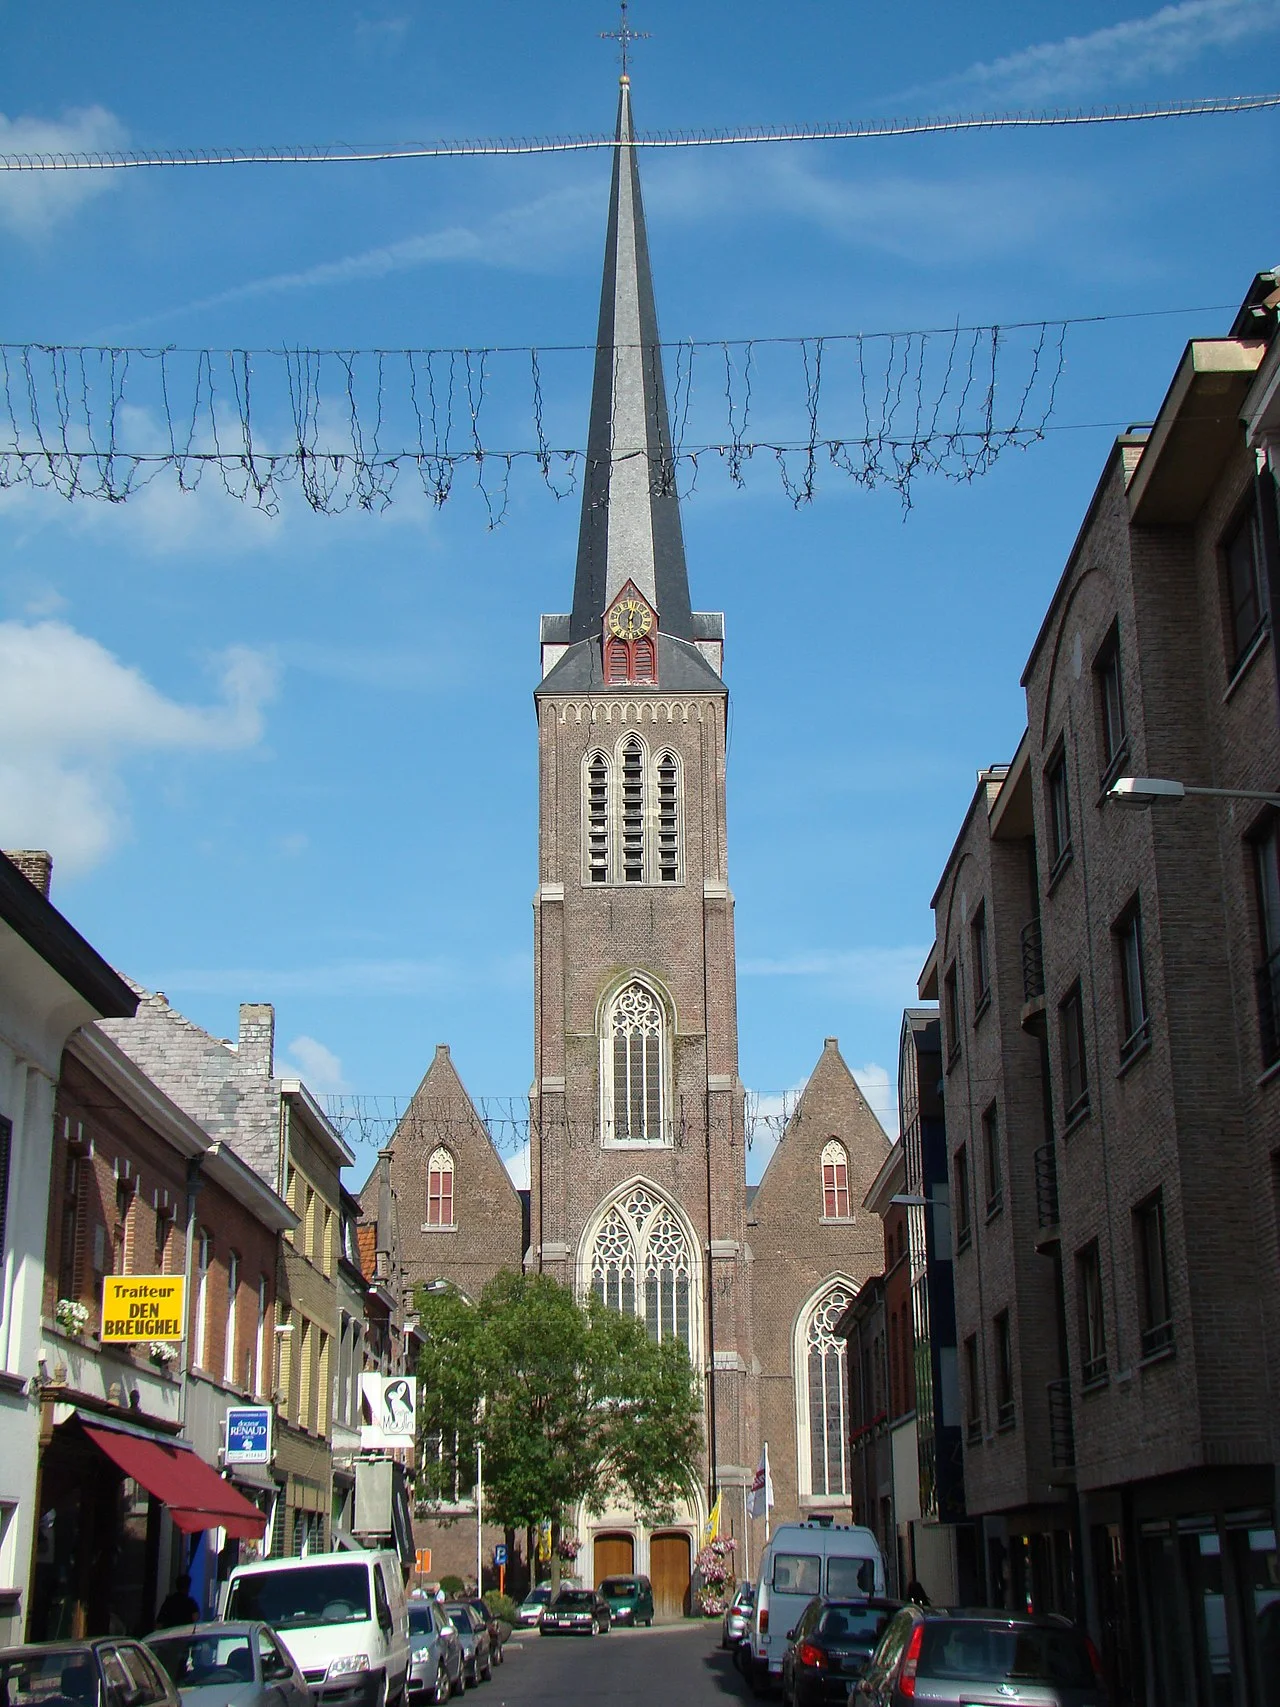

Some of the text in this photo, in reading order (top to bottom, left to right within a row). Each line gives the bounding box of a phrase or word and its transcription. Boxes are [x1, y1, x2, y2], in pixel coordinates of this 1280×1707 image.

[113, 1285, 175, 1298] Traiteur
[129, 1303, 159, 1318] DEN
[104, 1319, 181, 1335] BREUGHEL
[230, 1426, 267, 1436] RENAUD
[496, 1547, 506, 1560] P
